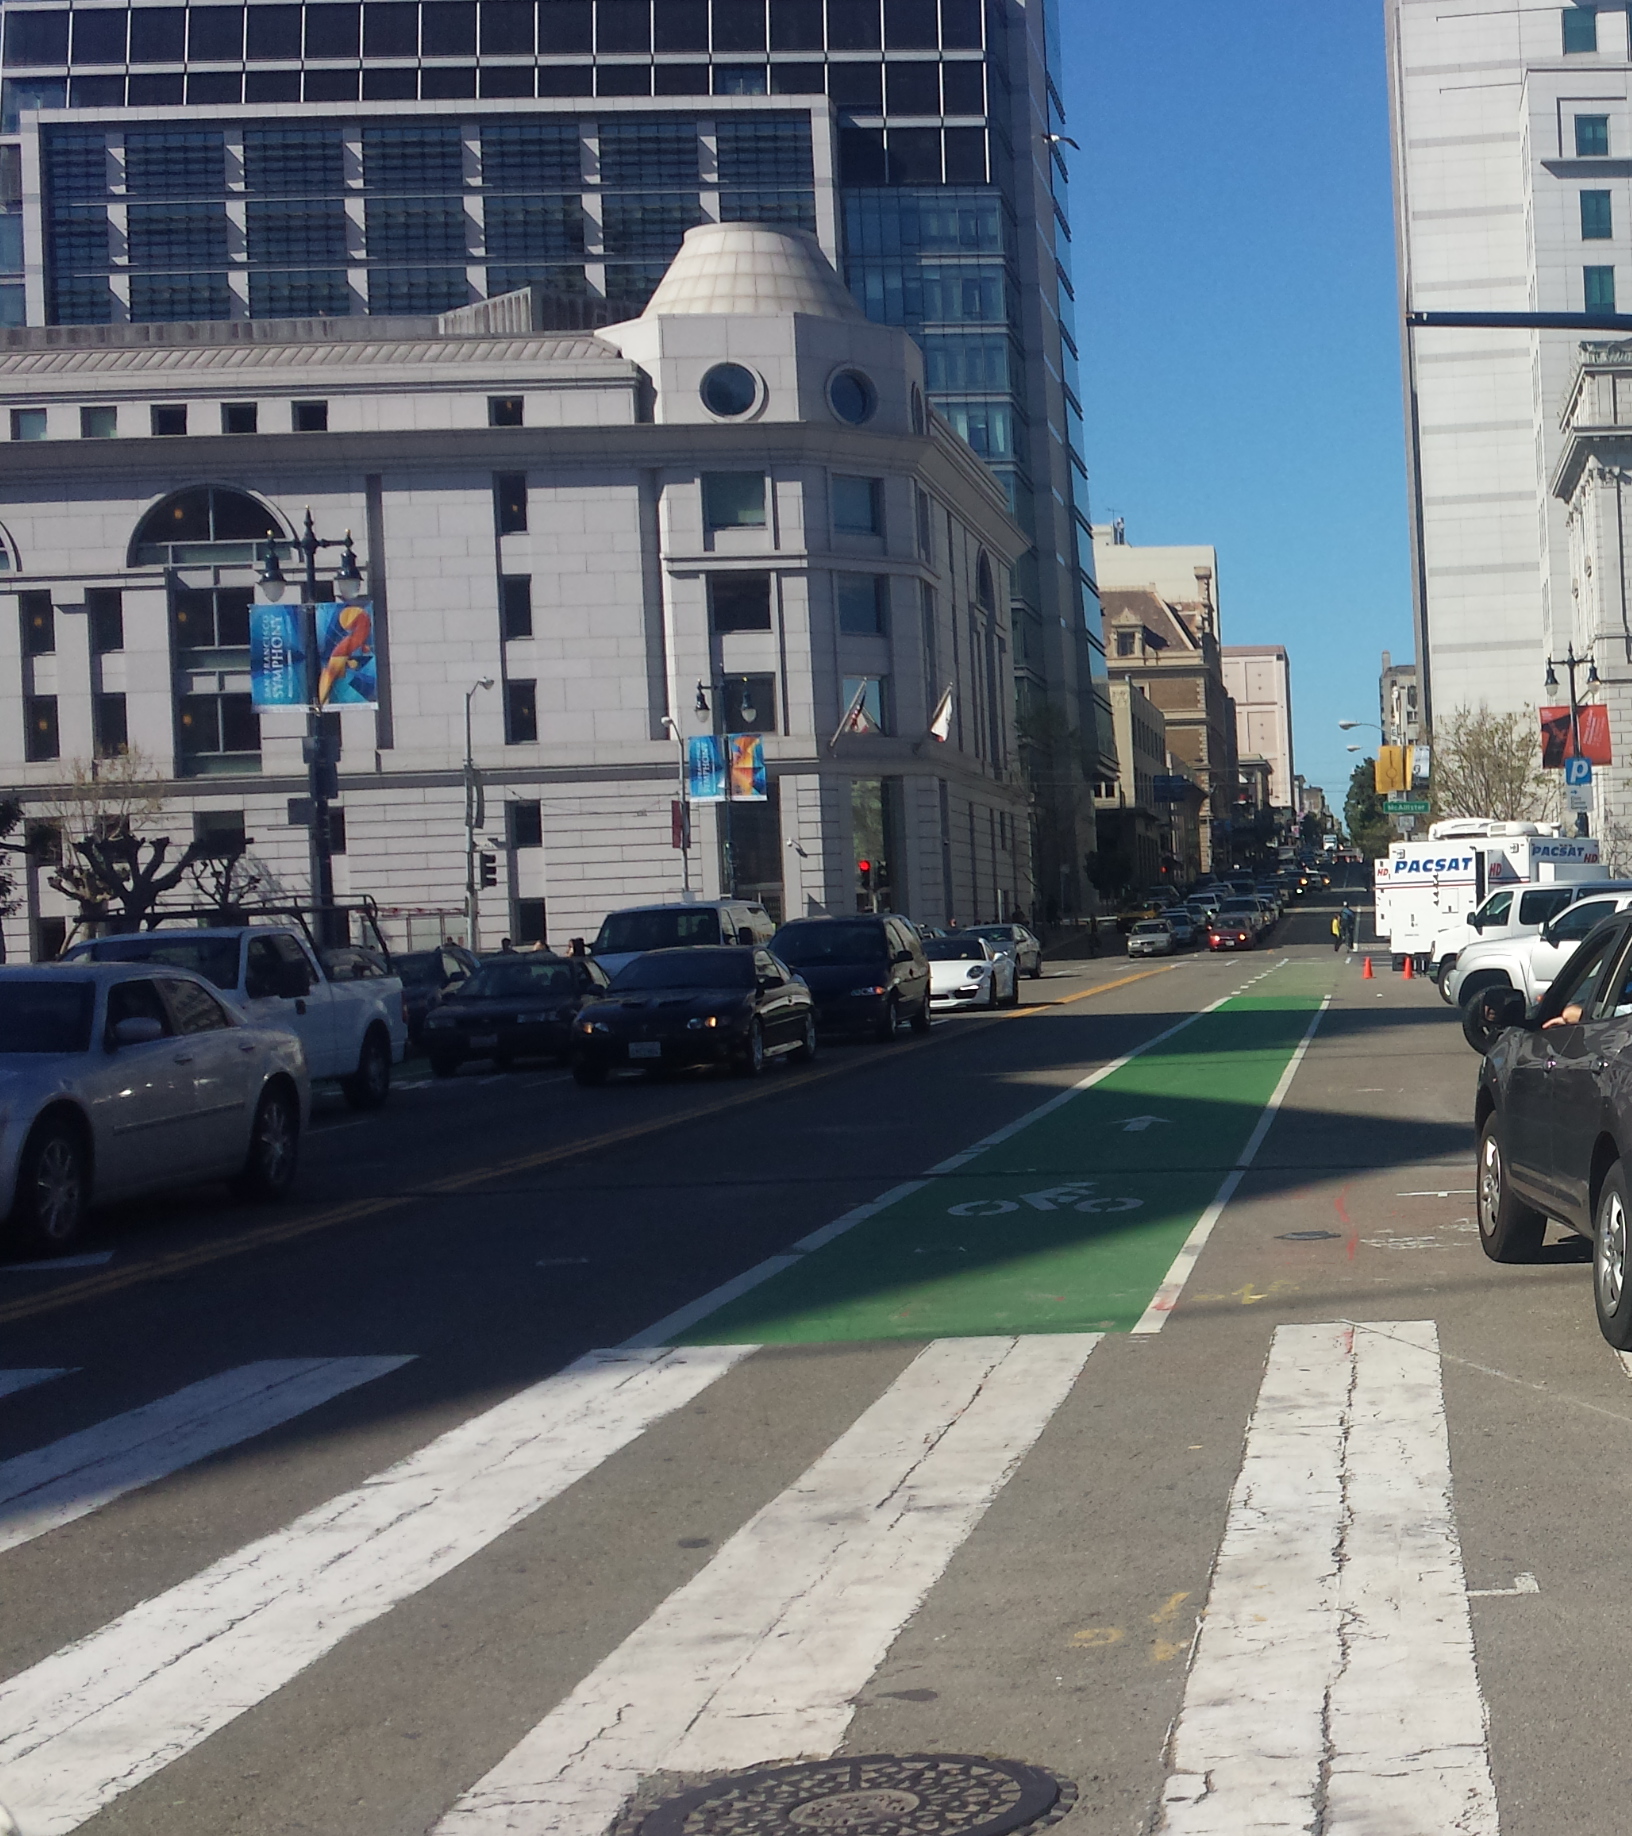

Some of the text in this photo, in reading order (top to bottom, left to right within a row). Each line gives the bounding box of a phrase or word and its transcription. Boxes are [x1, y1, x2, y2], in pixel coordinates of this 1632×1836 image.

[271, 614, 284, 699] SYMPHONY
[1570, 760, 1589, 783] P
[1531, 845, 1585, 858] PACSAT
[1583, 853, 1598, 863] HD
[1377, 868, 1389, 877] HD
[1394, 857, 1473, 874] PACSAT
[1489, 862, 1502, 877] HD
